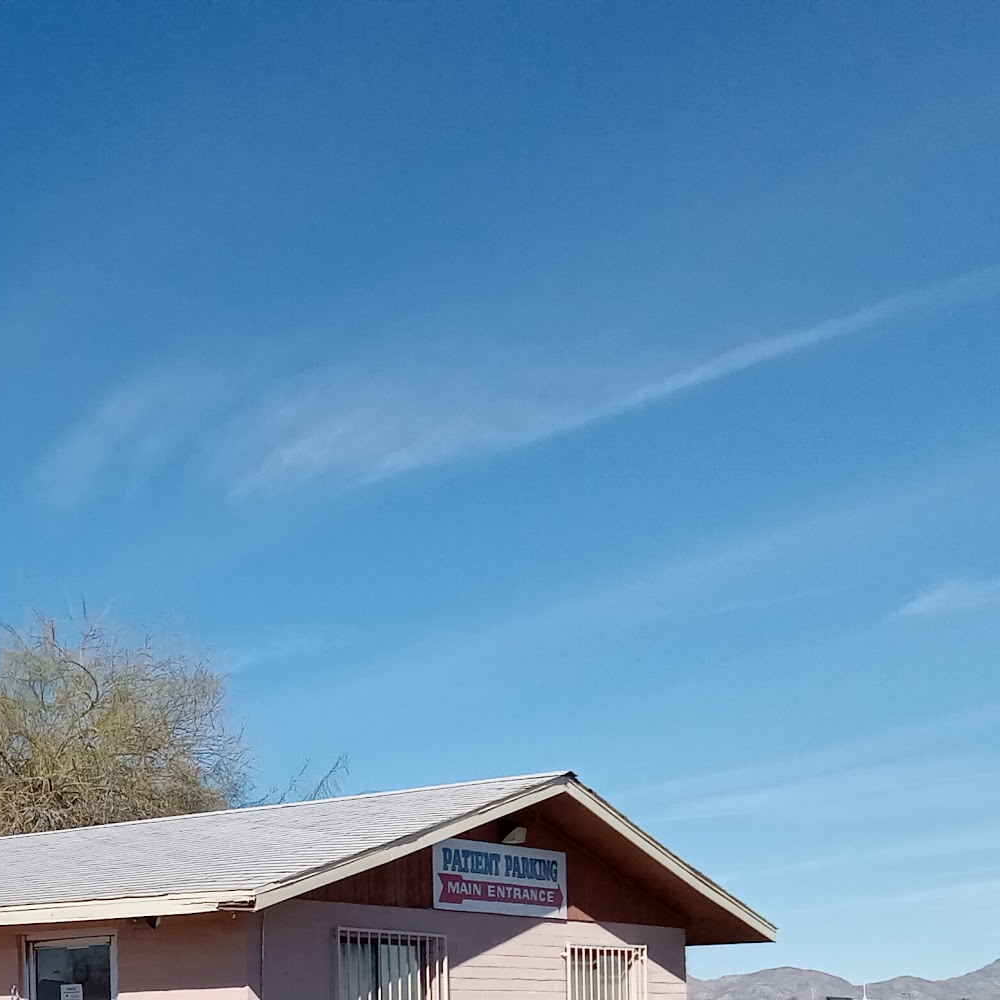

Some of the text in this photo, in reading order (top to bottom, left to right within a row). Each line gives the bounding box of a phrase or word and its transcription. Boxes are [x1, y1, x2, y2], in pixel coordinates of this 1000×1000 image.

[442, 847, 558, 882] PATIENT PARKING
[447, 881, 554, 902] MAIN ENTRANCE
